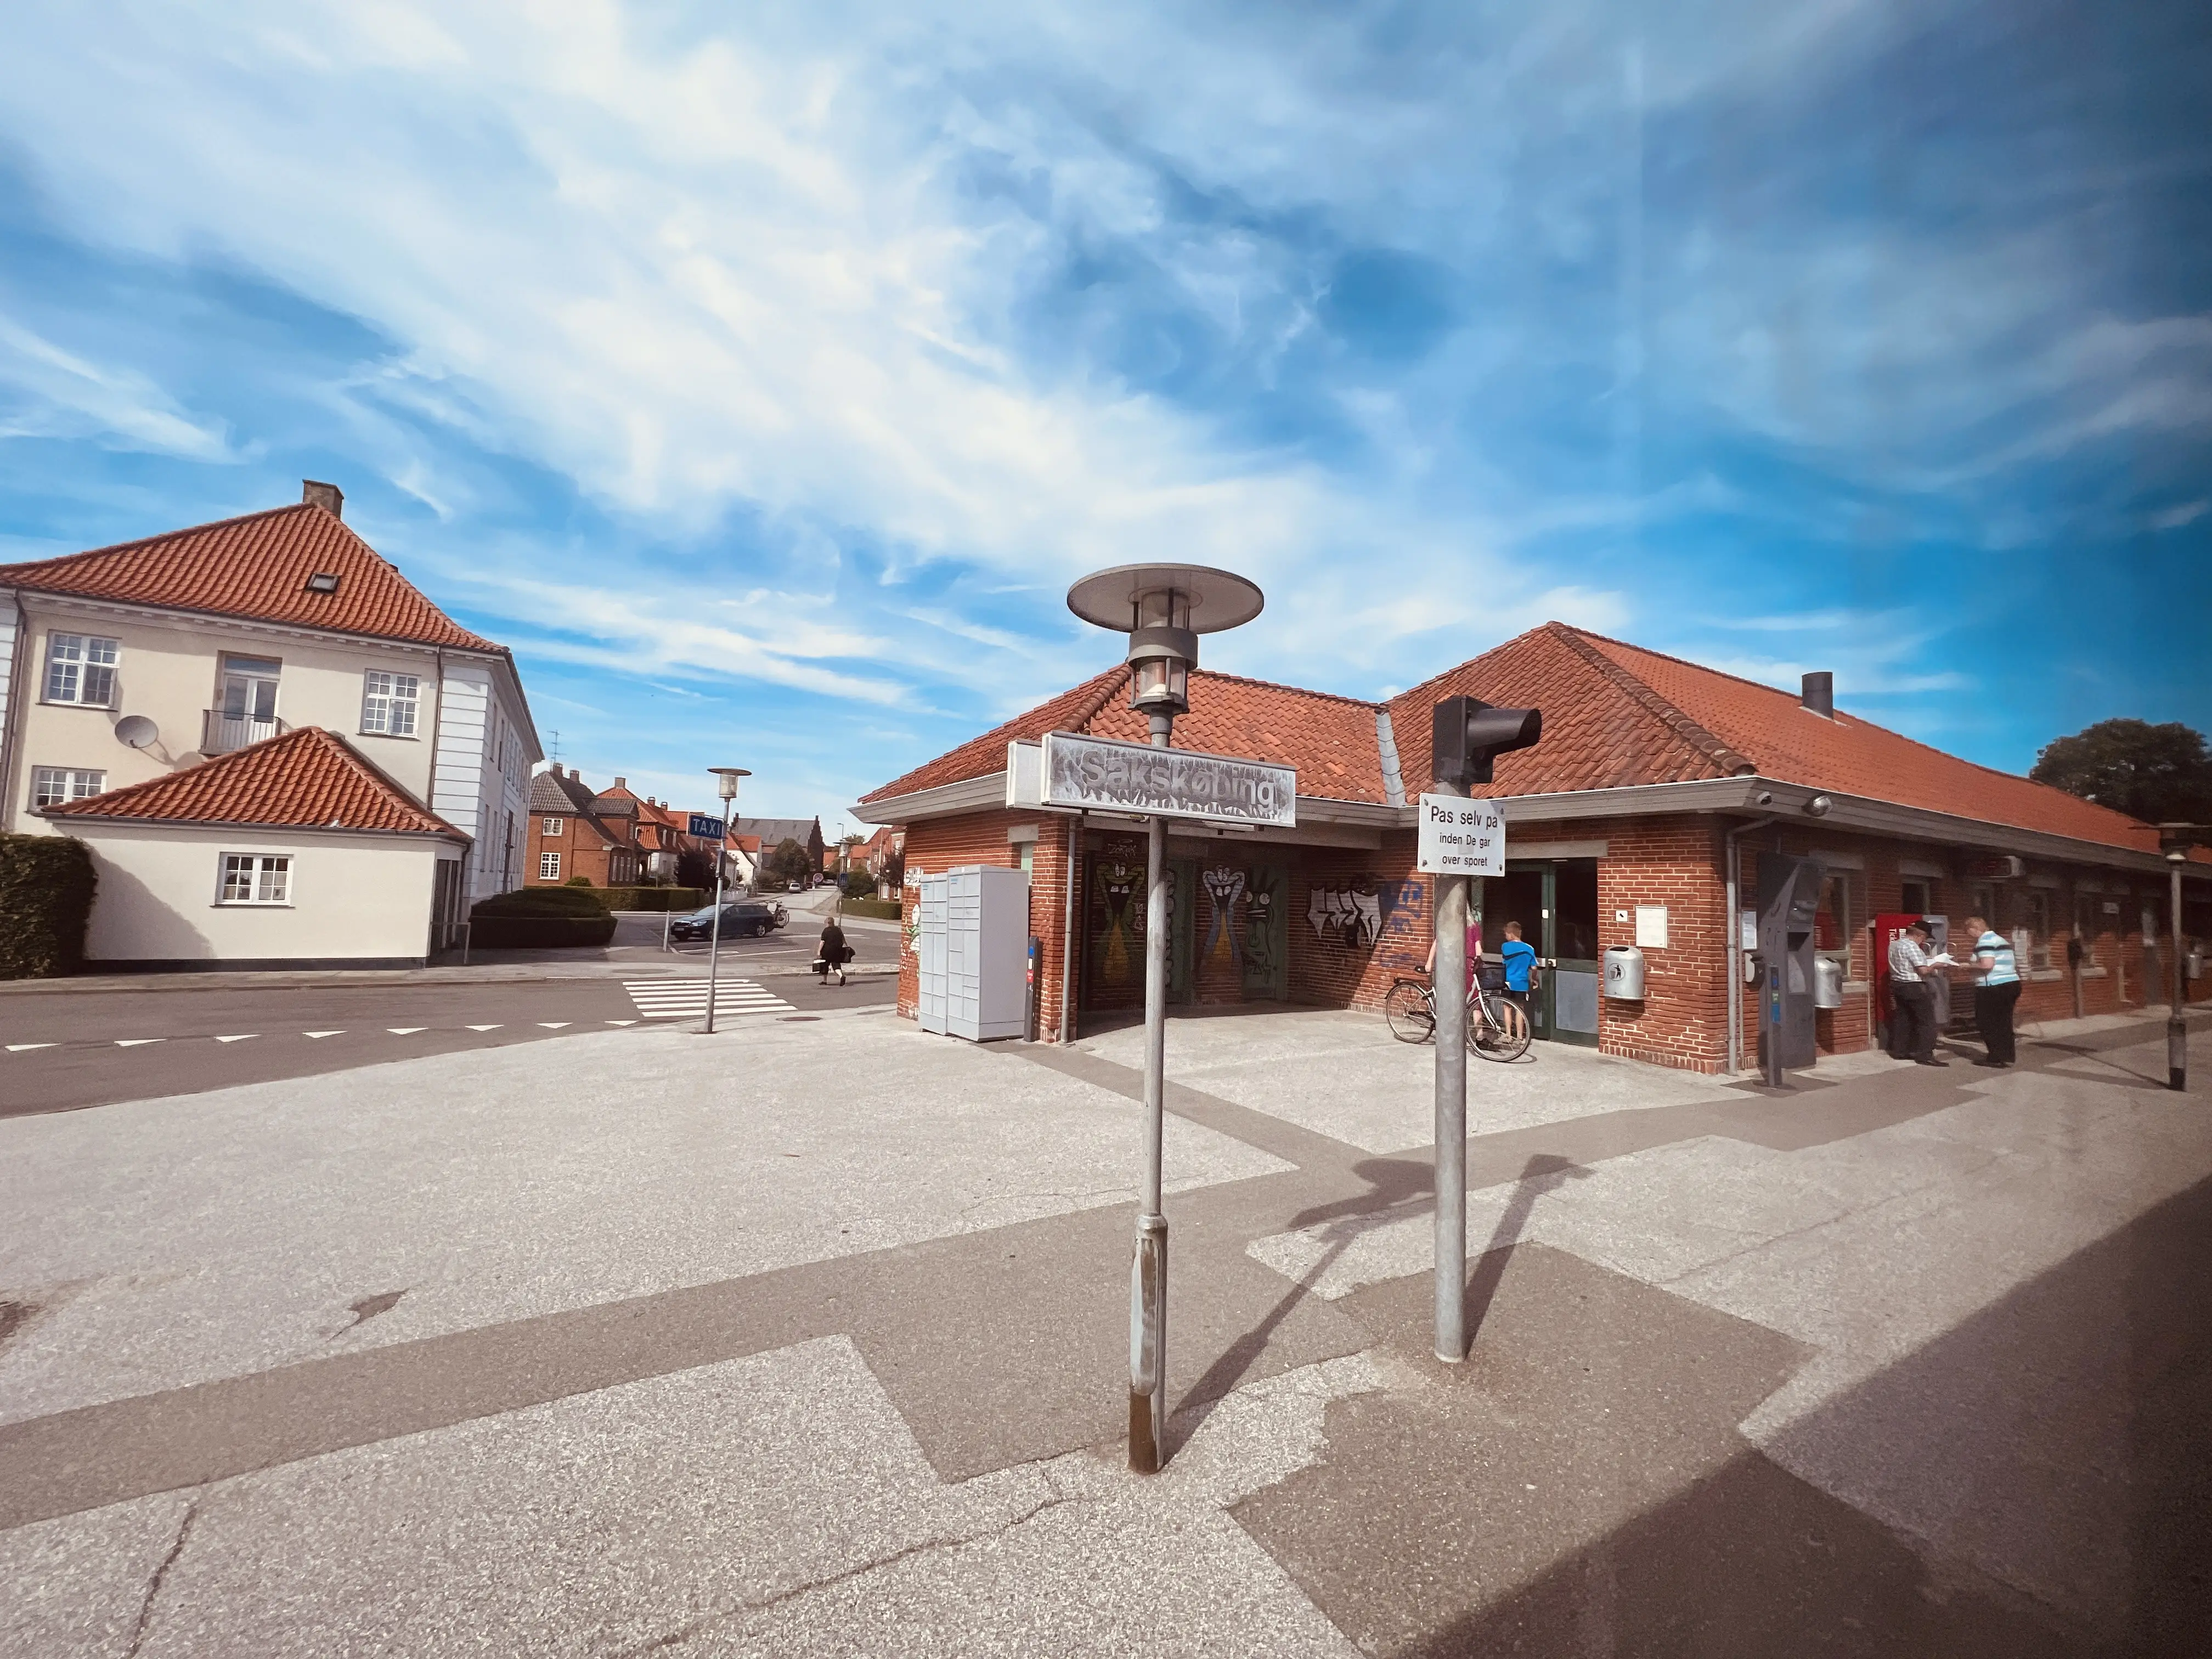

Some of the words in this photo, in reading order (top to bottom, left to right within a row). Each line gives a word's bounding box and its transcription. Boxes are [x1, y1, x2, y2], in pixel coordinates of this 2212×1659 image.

[1081, 750, 1274, 810] Sakskøbing
[1431, 805, 1454, 823] Pas
[1460, 810, 1482, 827] selv
[693, 819, 720, 836] TAXI
[1439, 832, 1463, 845] inden
[1466, 834, 1477, 846] De
[1442, 855, 1460, 865] over
[1464, 856, 1488, 868] sporet
